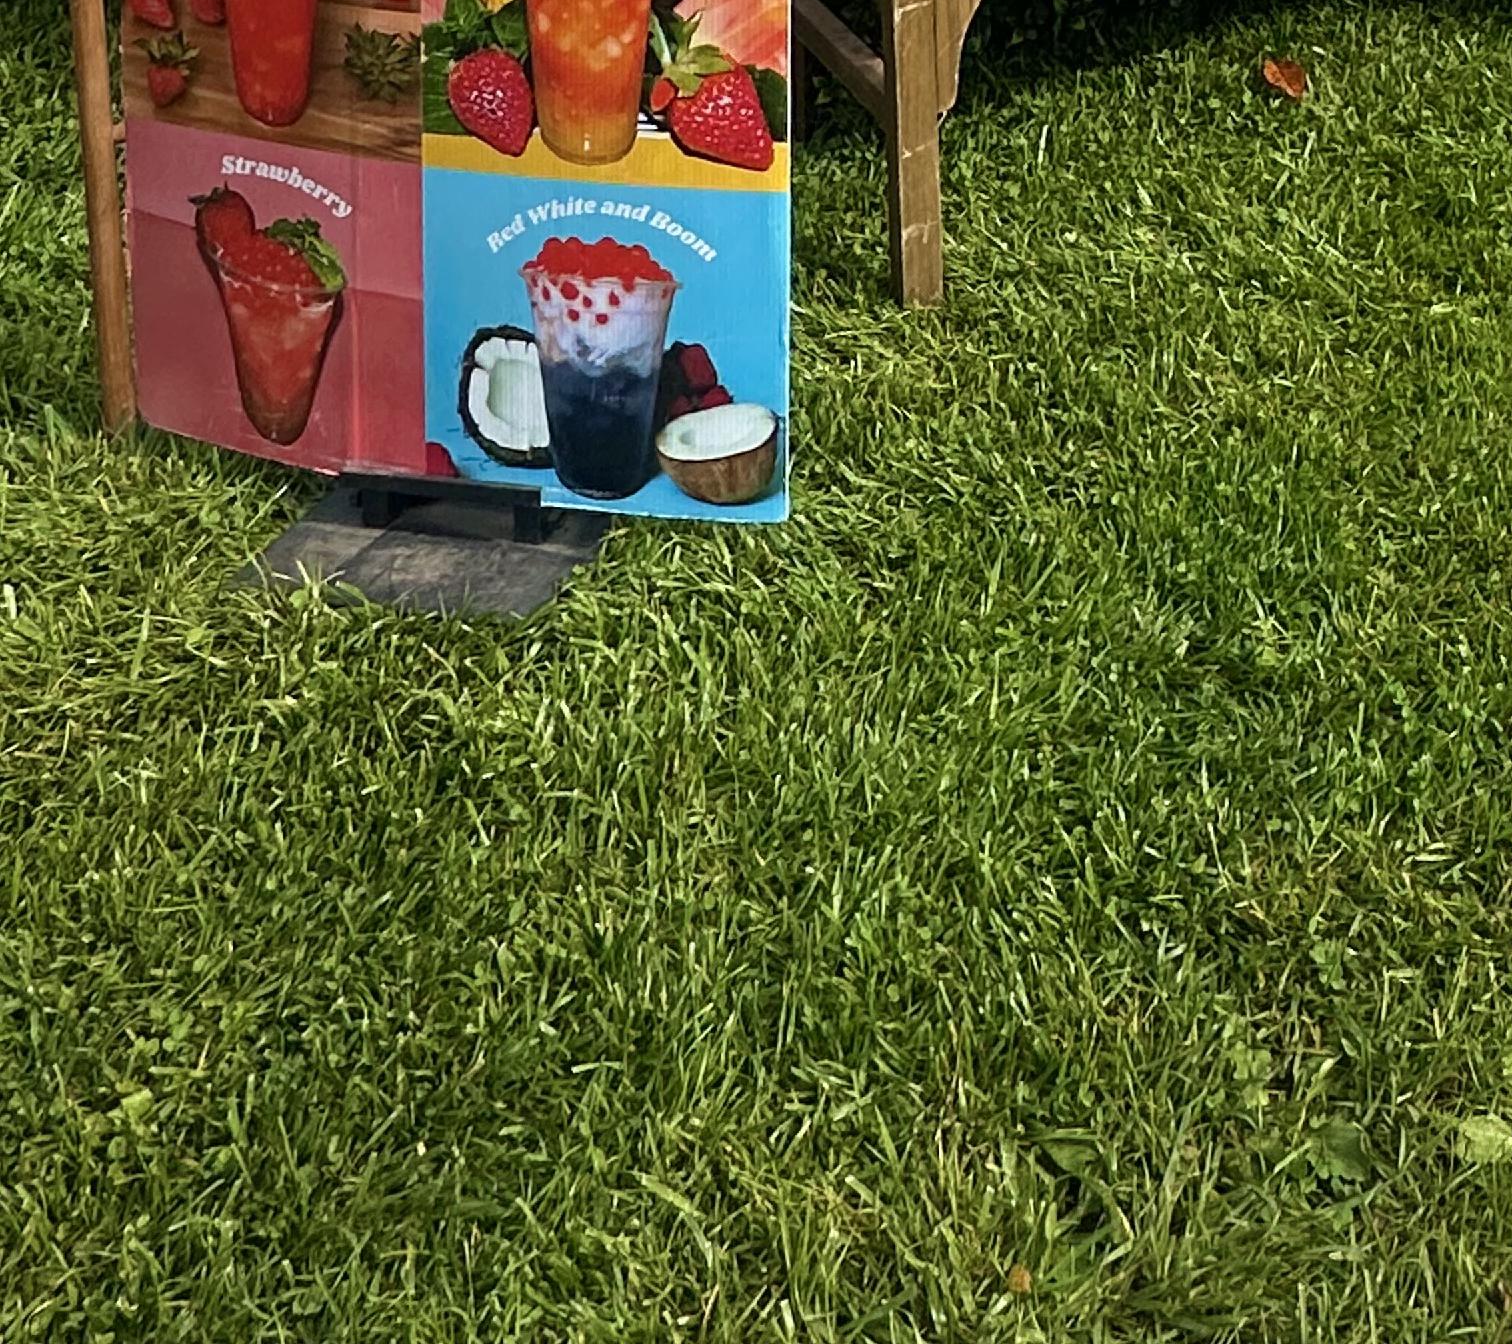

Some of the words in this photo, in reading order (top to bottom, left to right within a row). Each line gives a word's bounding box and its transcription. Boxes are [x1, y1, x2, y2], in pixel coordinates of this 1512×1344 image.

[220, 154, 354, 219] Strawberry
[486, 213, 527, 255] Red
[526, 195, 598, 226] White
[599, 199, 651, 223] and
[648, 210, 719, 263] Boom
